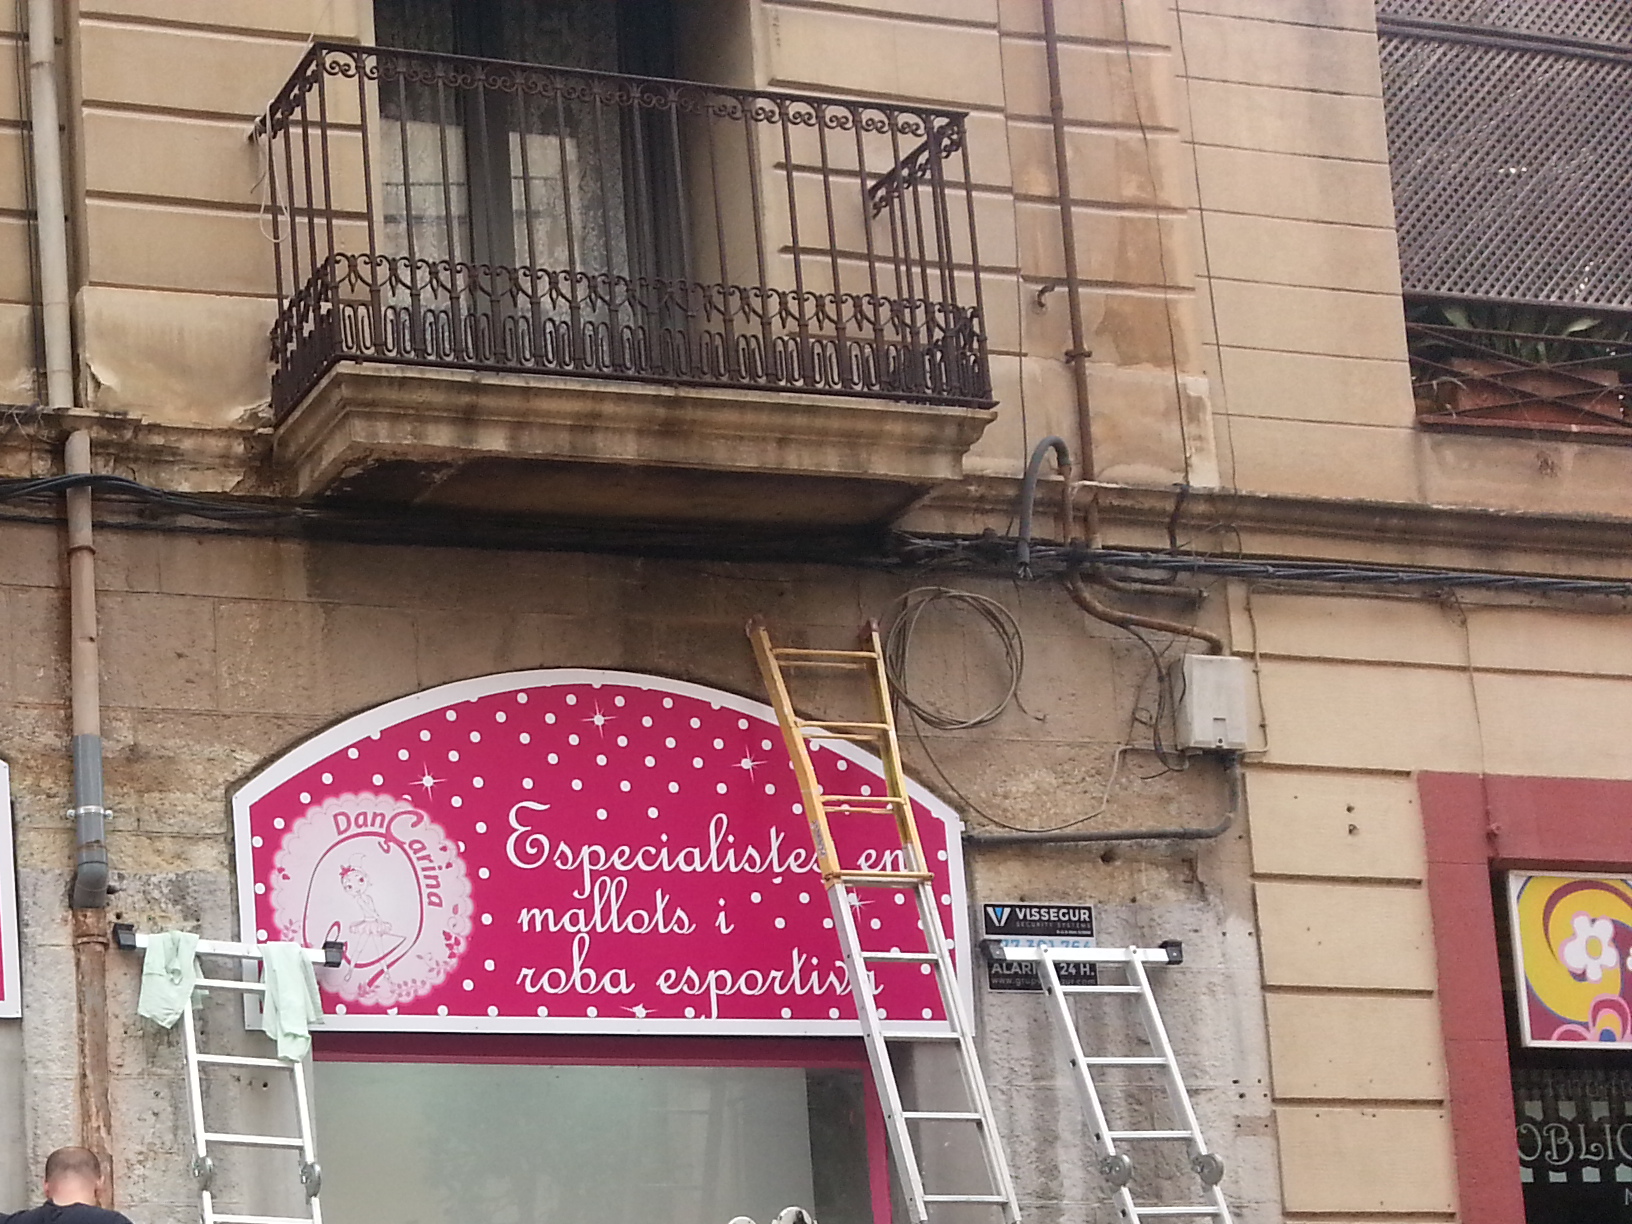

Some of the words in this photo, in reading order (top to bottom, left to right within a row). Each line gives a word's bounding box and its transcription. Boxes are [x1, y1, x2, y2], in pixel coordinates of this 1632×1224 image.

[856, 848, 908, 872] en
[517, 876, 696, 934] mallots
[715, 898, 735, 934] i
[1014, 907, 1090, 922] VISSEGUR
[516, 932, 635, 994] roba
[1059, 963, 1077, 975] 24
[1080, 963, 1095, 976] H.
